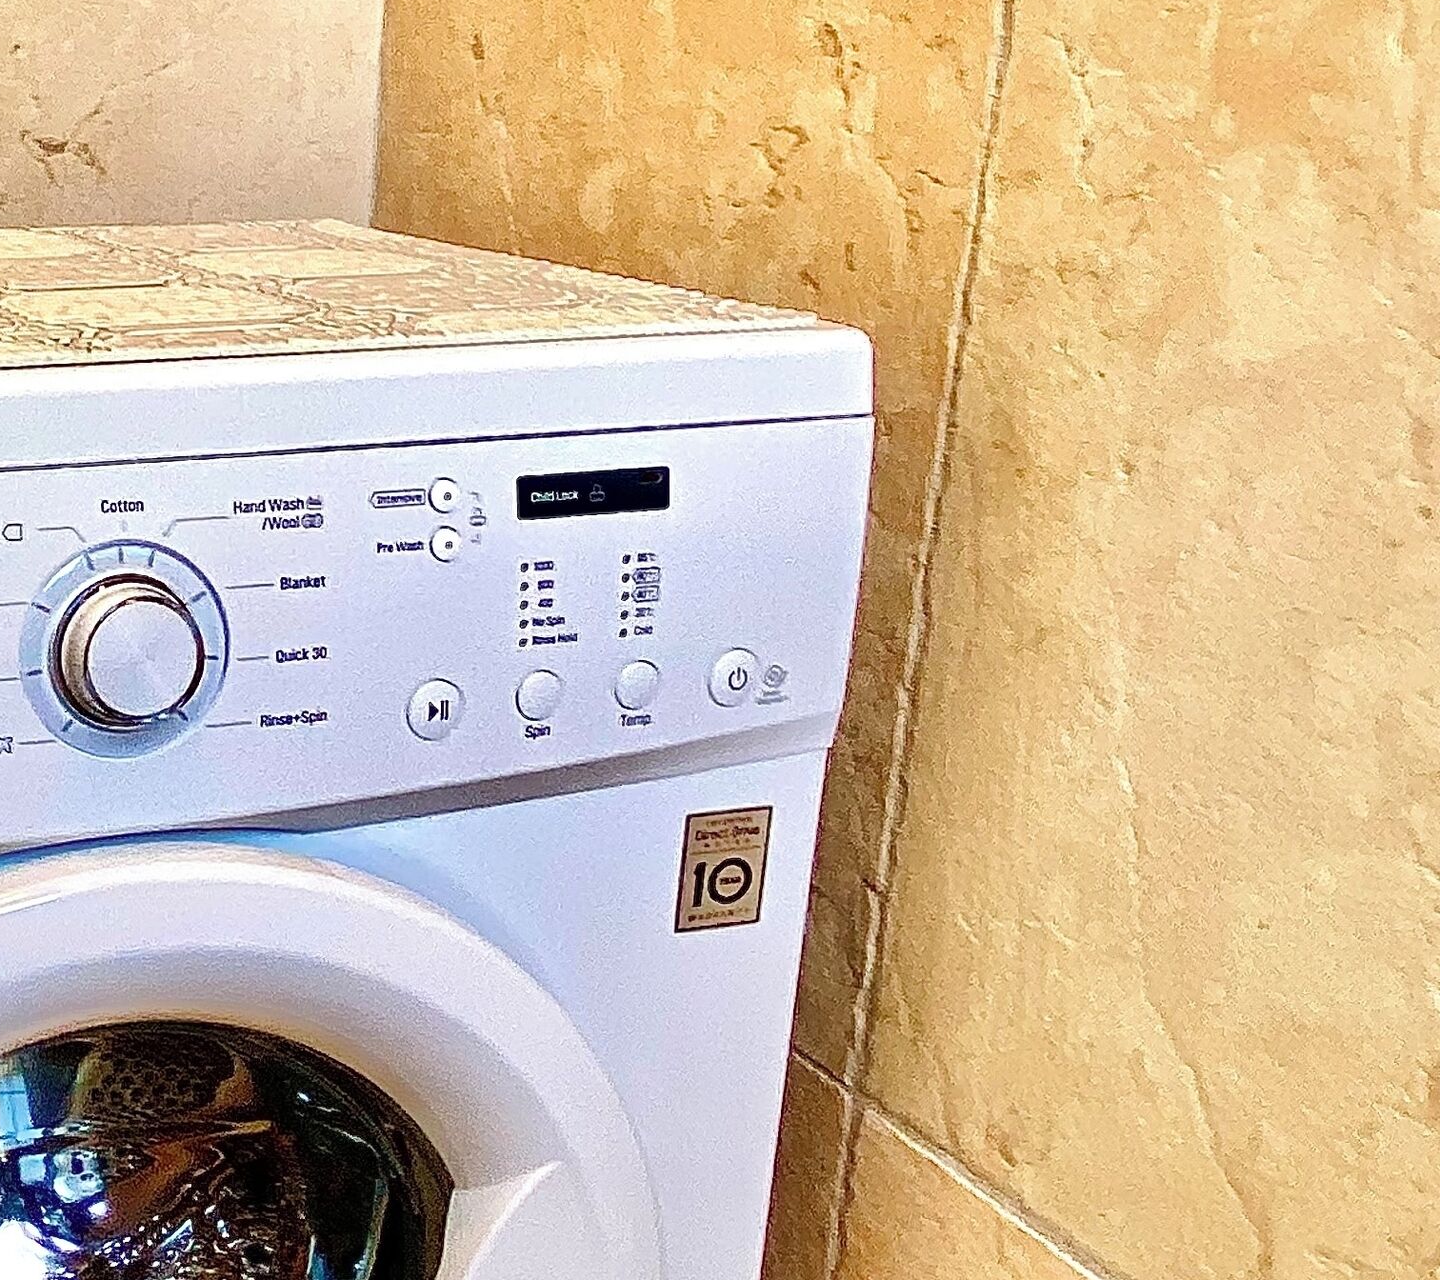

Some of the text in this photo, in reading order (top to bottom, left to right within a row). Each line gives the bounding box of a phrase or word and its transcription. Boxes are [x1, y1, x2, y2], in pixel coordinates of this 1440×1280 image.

[100, 498, 145, 514] Cotton
[233, 496, 305, 515] Hand Wash
[279, 574, 327, 591] Blanket
[275, 645, 328, 664] Quick 30
[259, 709, 329, 729] Rinse+Spin
[620, 713, 653, 730] Temp
[524, 723, 552, 741] Spin
